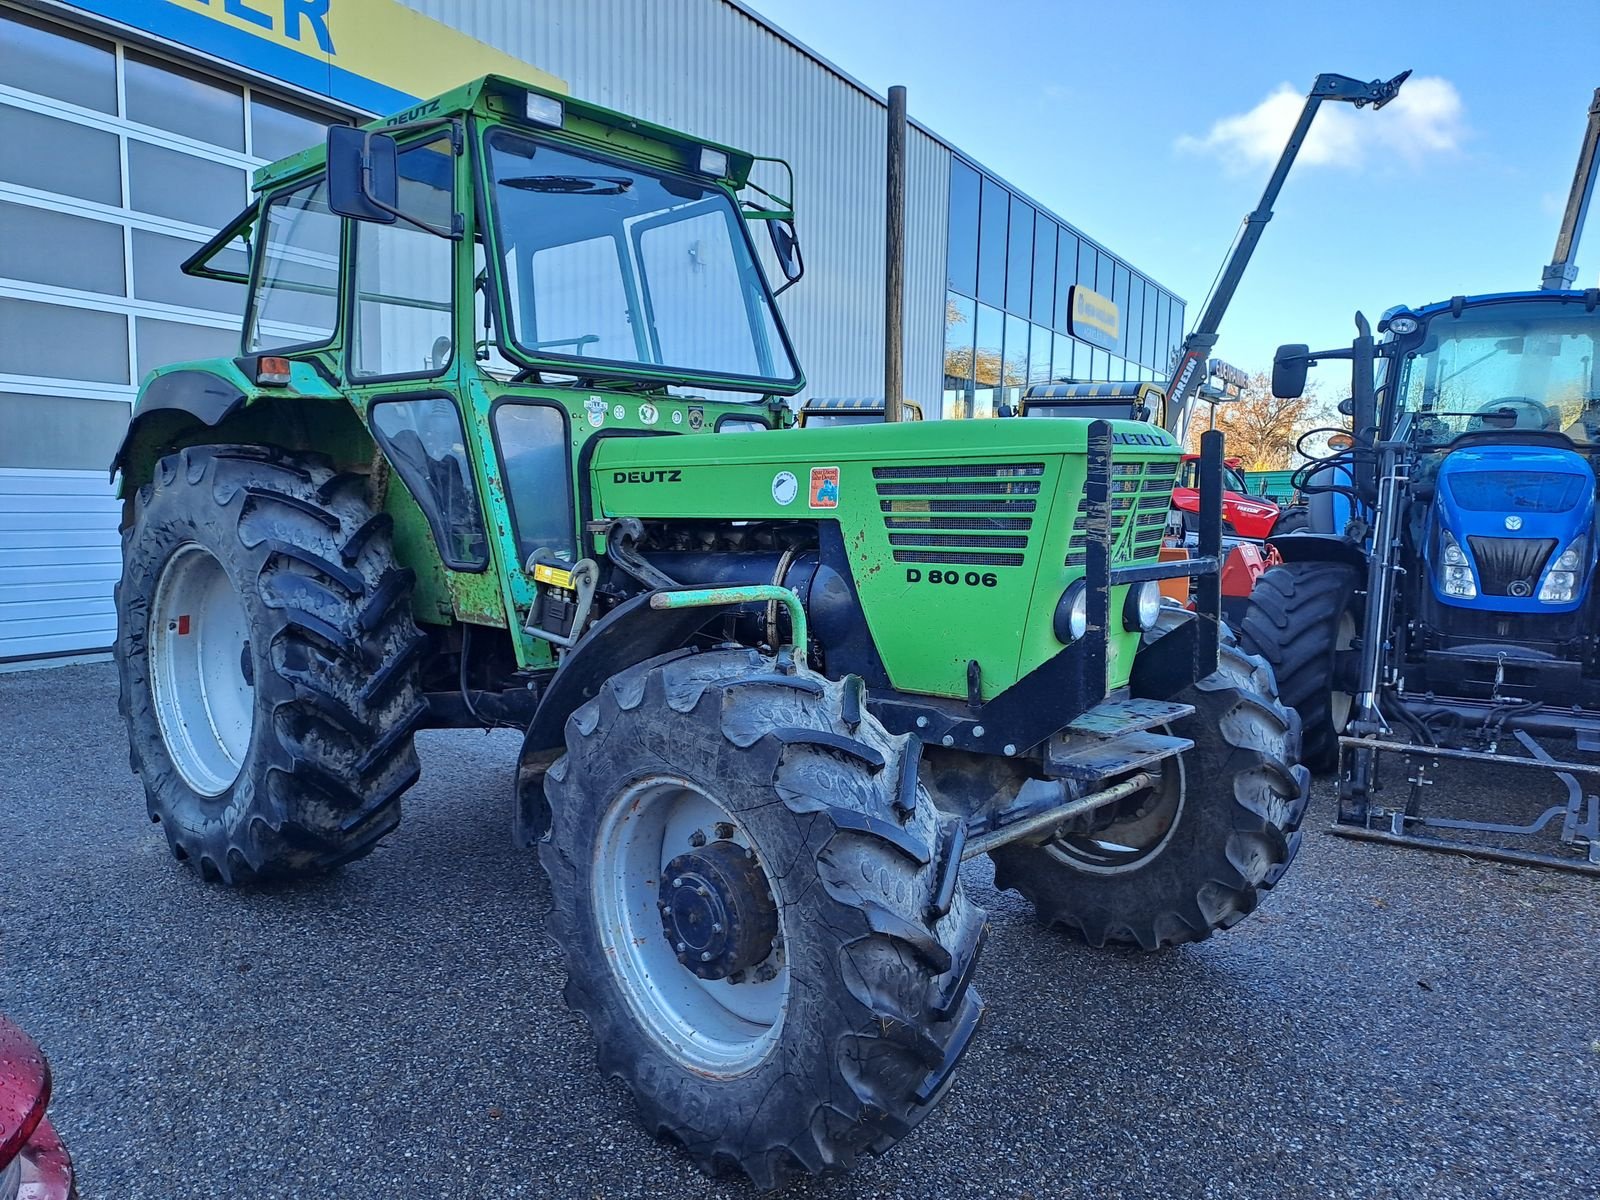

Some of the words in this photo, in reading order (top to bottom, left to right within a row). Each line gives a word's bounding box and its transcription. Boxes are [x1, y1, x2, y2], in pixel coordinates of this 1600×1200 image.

[386, 98, 441, 127] DEUTZ
[1171, 357, 1198, 403] FARESIN
[1112, 432, 1172, 447] DEUTZ
[613, 470, 682, 484] DEUTZ
[906, 568, 922, 583] D
